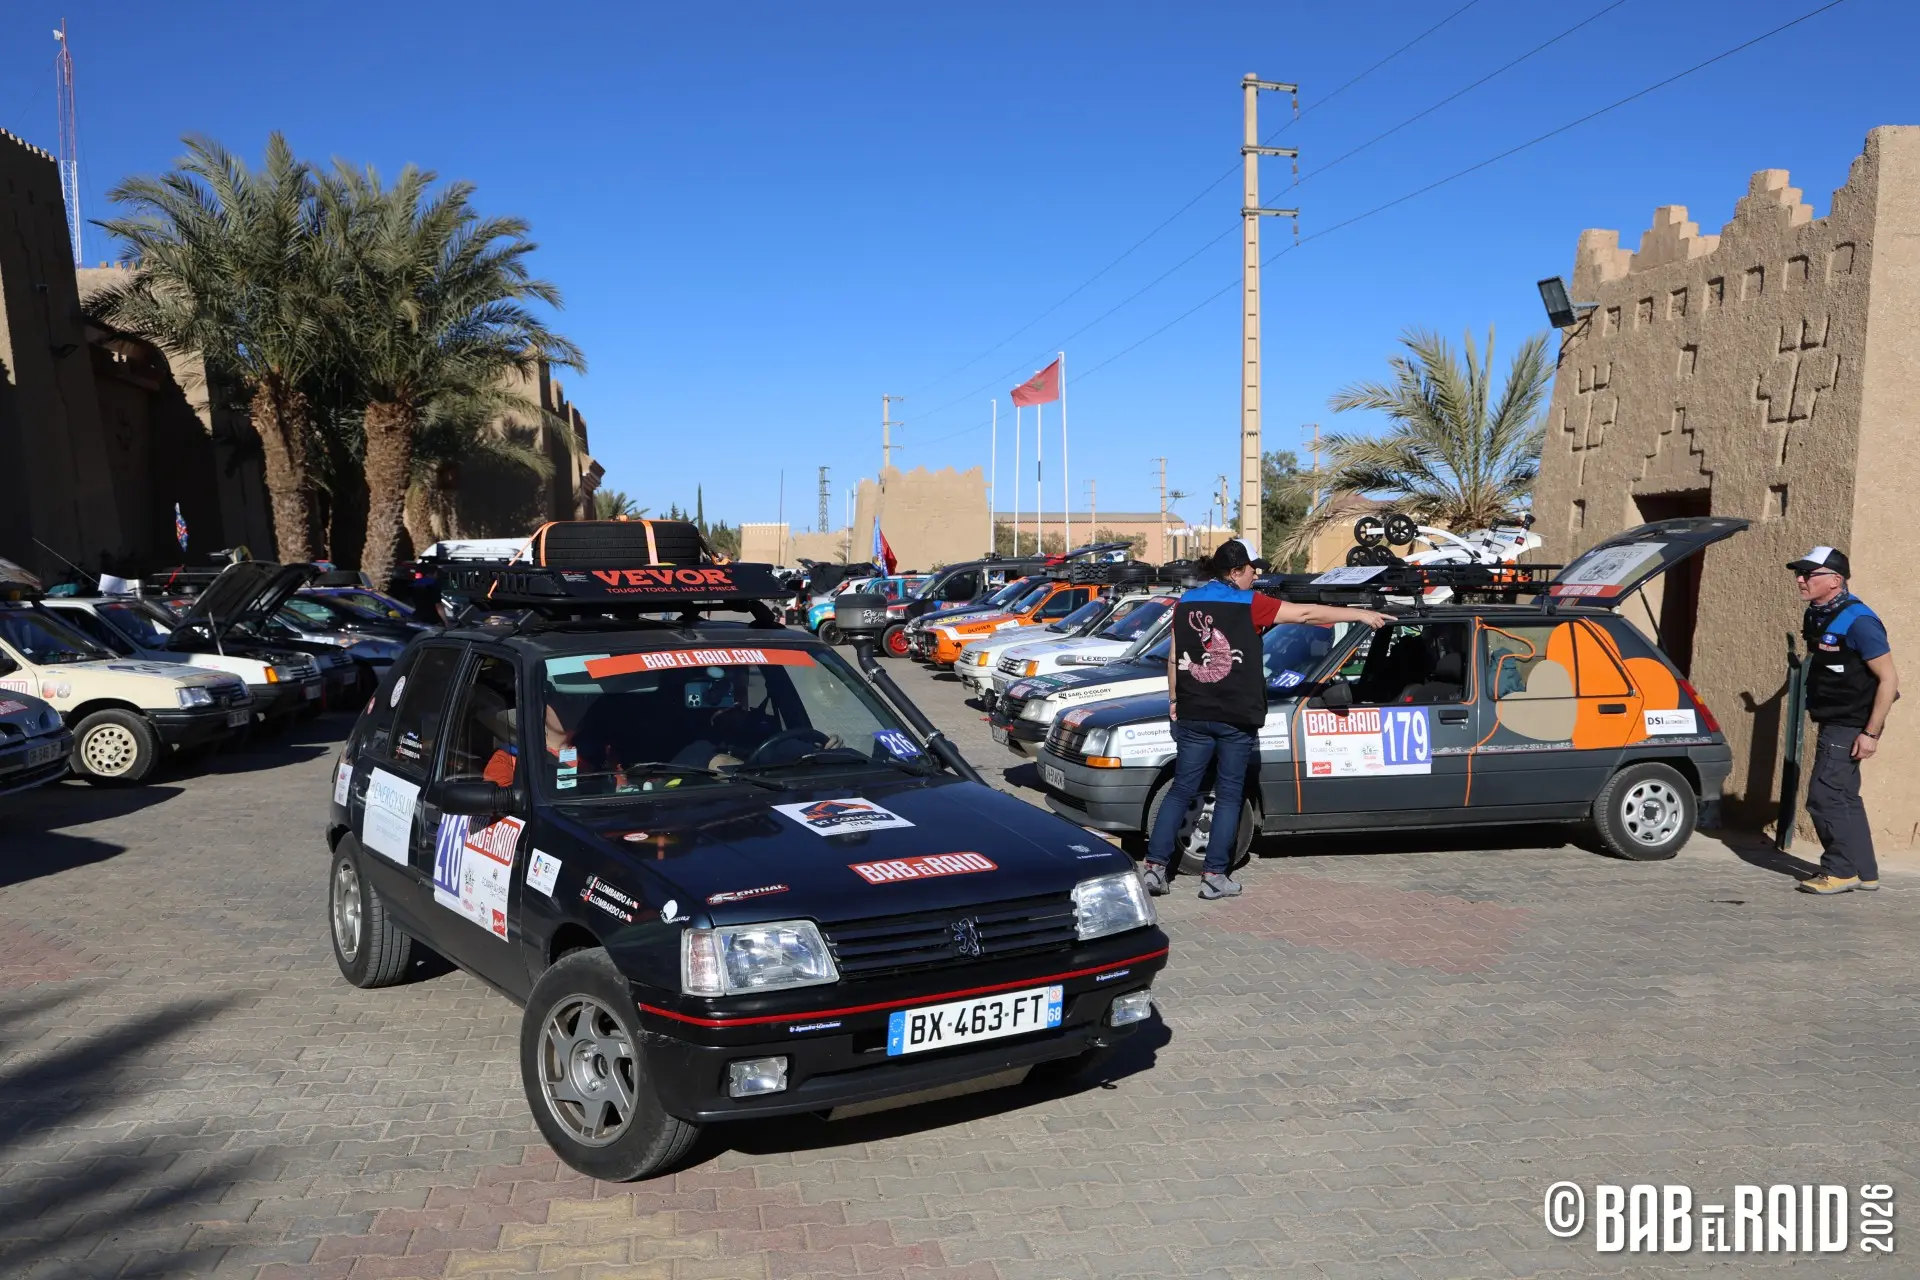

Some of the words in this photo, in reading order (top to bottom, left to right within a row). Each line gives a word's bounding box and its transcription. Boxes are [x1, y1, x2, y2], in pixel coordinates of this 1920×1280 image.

[591, 568, 733, 586] VEVOR
[641, 652, 678, 669] BAB
[677, 653, 697, 666] EL
[694, 650, 769, 665] RAID.COM
[1274, 671, 1300, 688] 179
[1308, 712, 1338, 734] BAB
[1347, 711, 1381, 733] RAID
[1647, 716, 1664, 725] DSI
[880, 732, 917, 755] 216
[1383, 710, 1429, 762] 179
[831, 814, 888, 822] CONCEPT
[489, 821, 519, 860] RAID
[434, 812, 468, 891] 216
[855, 860, 920, 882] BAB
[922, 852, 994, 874] RAID
[1047, 1007, 1061, 1022] 68
[892, 1037, 900, 1047] F
